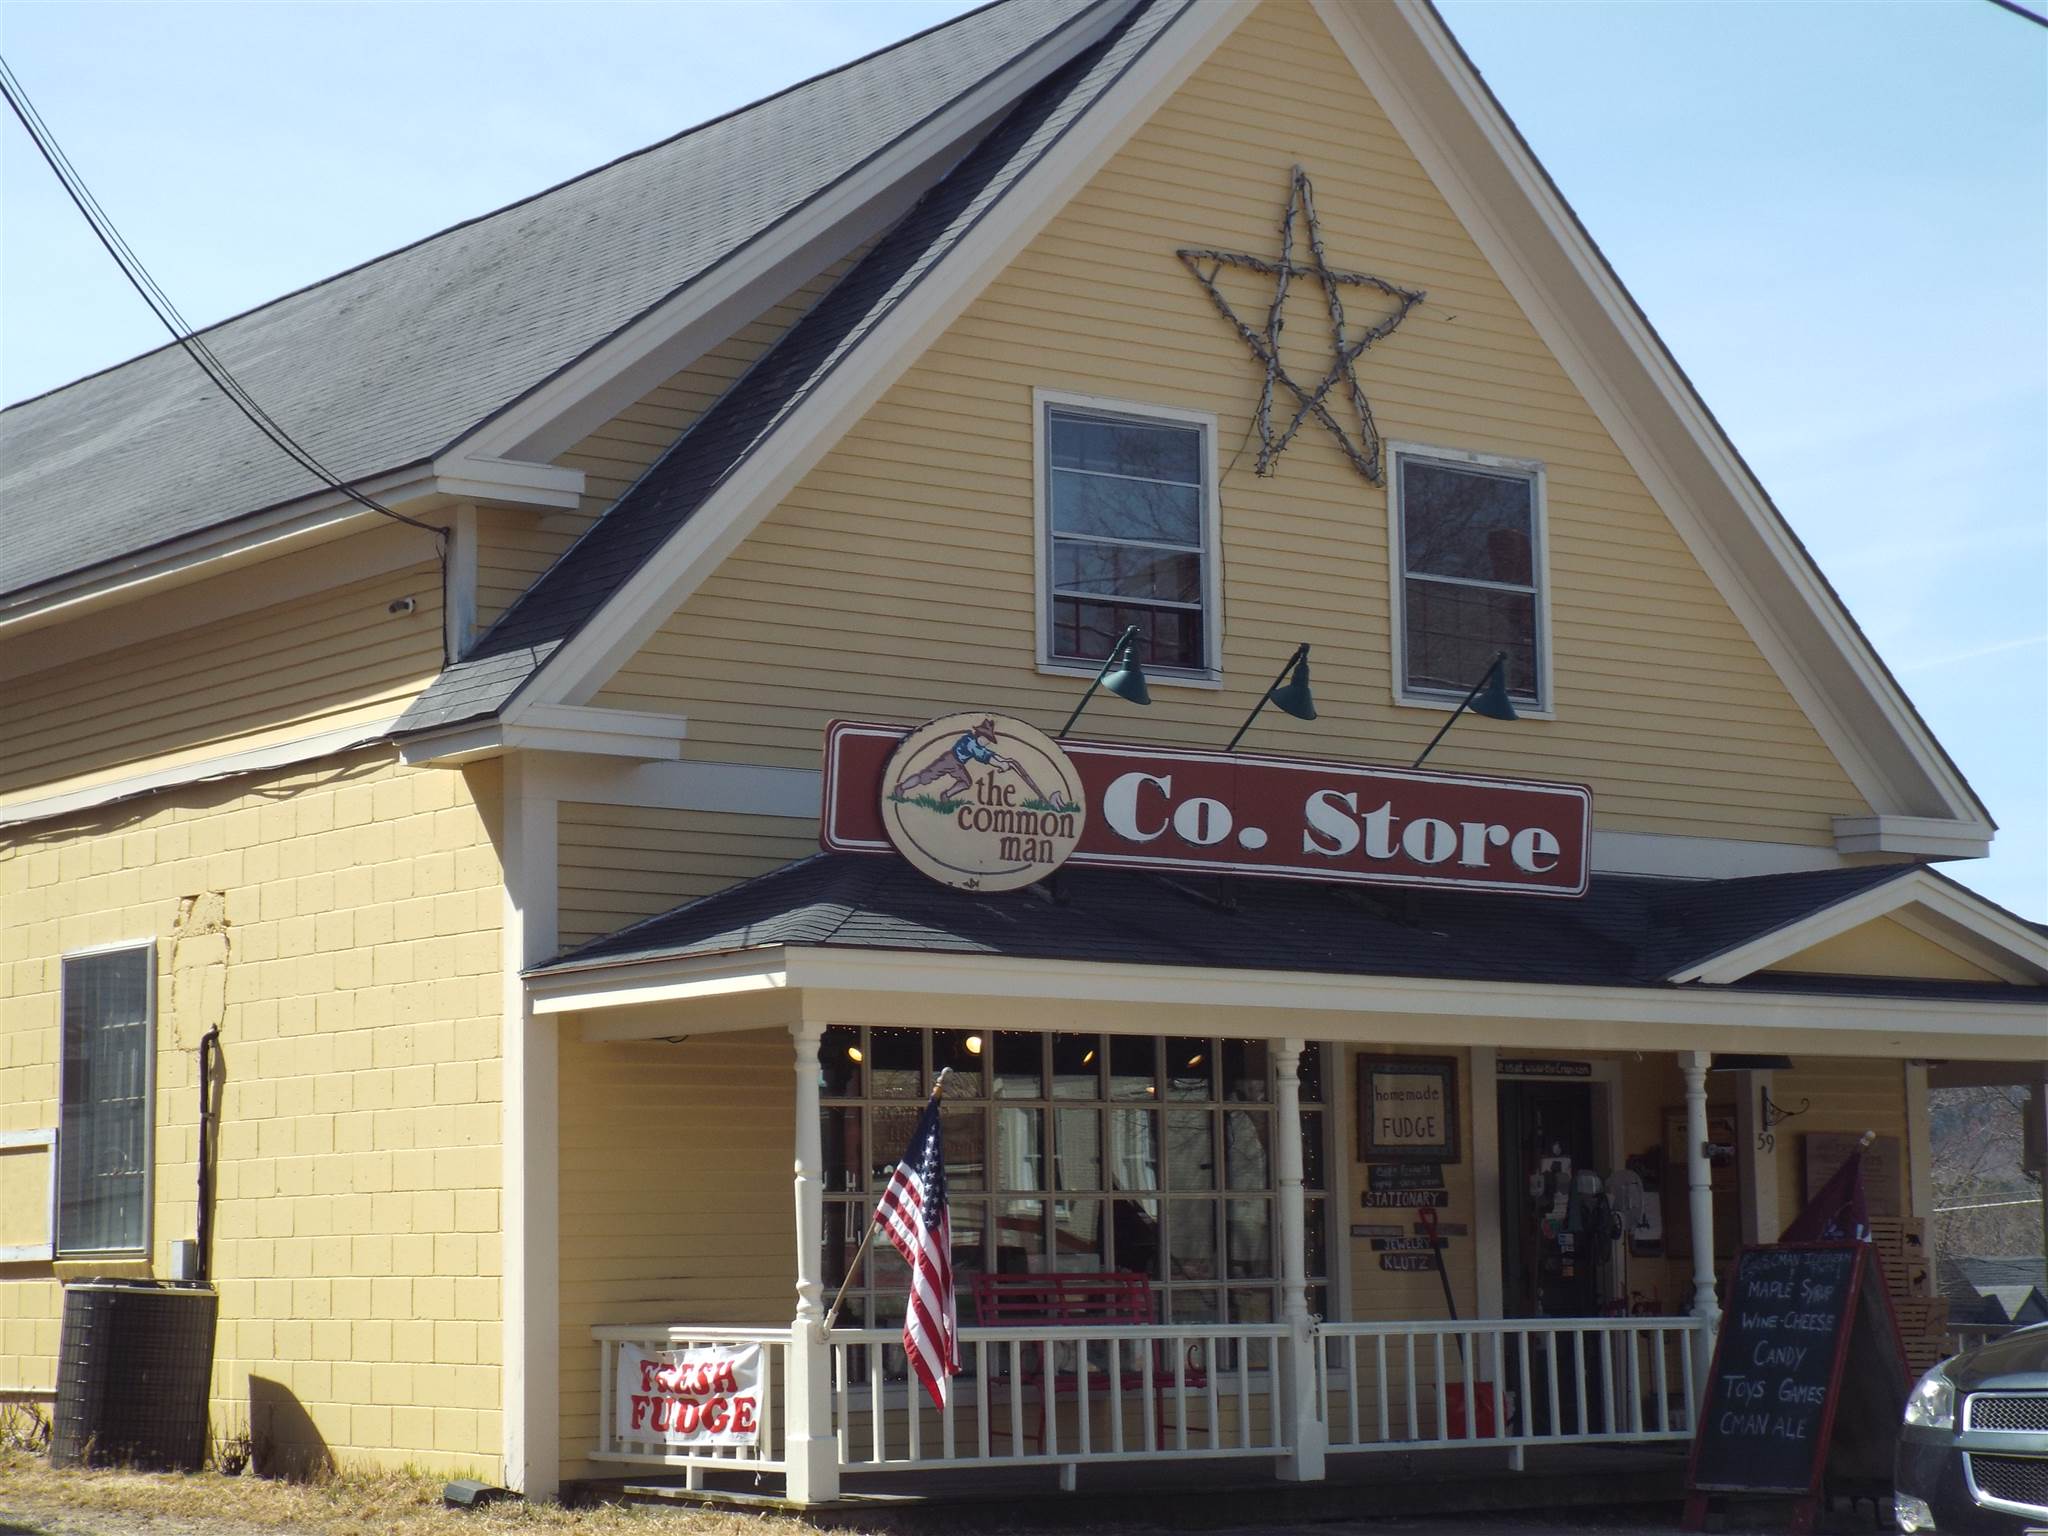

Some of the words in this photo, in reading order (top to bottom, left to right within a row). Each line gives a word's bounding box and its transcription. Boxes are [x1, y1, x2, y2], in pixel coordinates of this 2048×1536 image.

[975, 770, 1016, 807] the
[958, 805, 1075, 838] common
[1102, 771, 1268, 849] Co.
[1303, 788, 1561, 875] Store
[999, 836, 1055, 864] man
[1375, 1084, 1439, 1101] homemade
[1382, 1116, 1436, 1138] FUDGE
[1755, 1132, 1776, 1153] 59
[1366, 1191, 1440, 1207] STATIONARY
[1384, 1255, 1430, 1270] KLUTZ
[1748, 1279, 1795, 1298] MAPLE
[1753, 1341, 1807, 1371] CANDY
[640, 1360, 738, 1395] FRESH
[631, 1395, 757, 1433] FUDGE
[1720, 1411, 1769, 1437] CMAN
[1774, 1417, 1808, 1440] ALE
